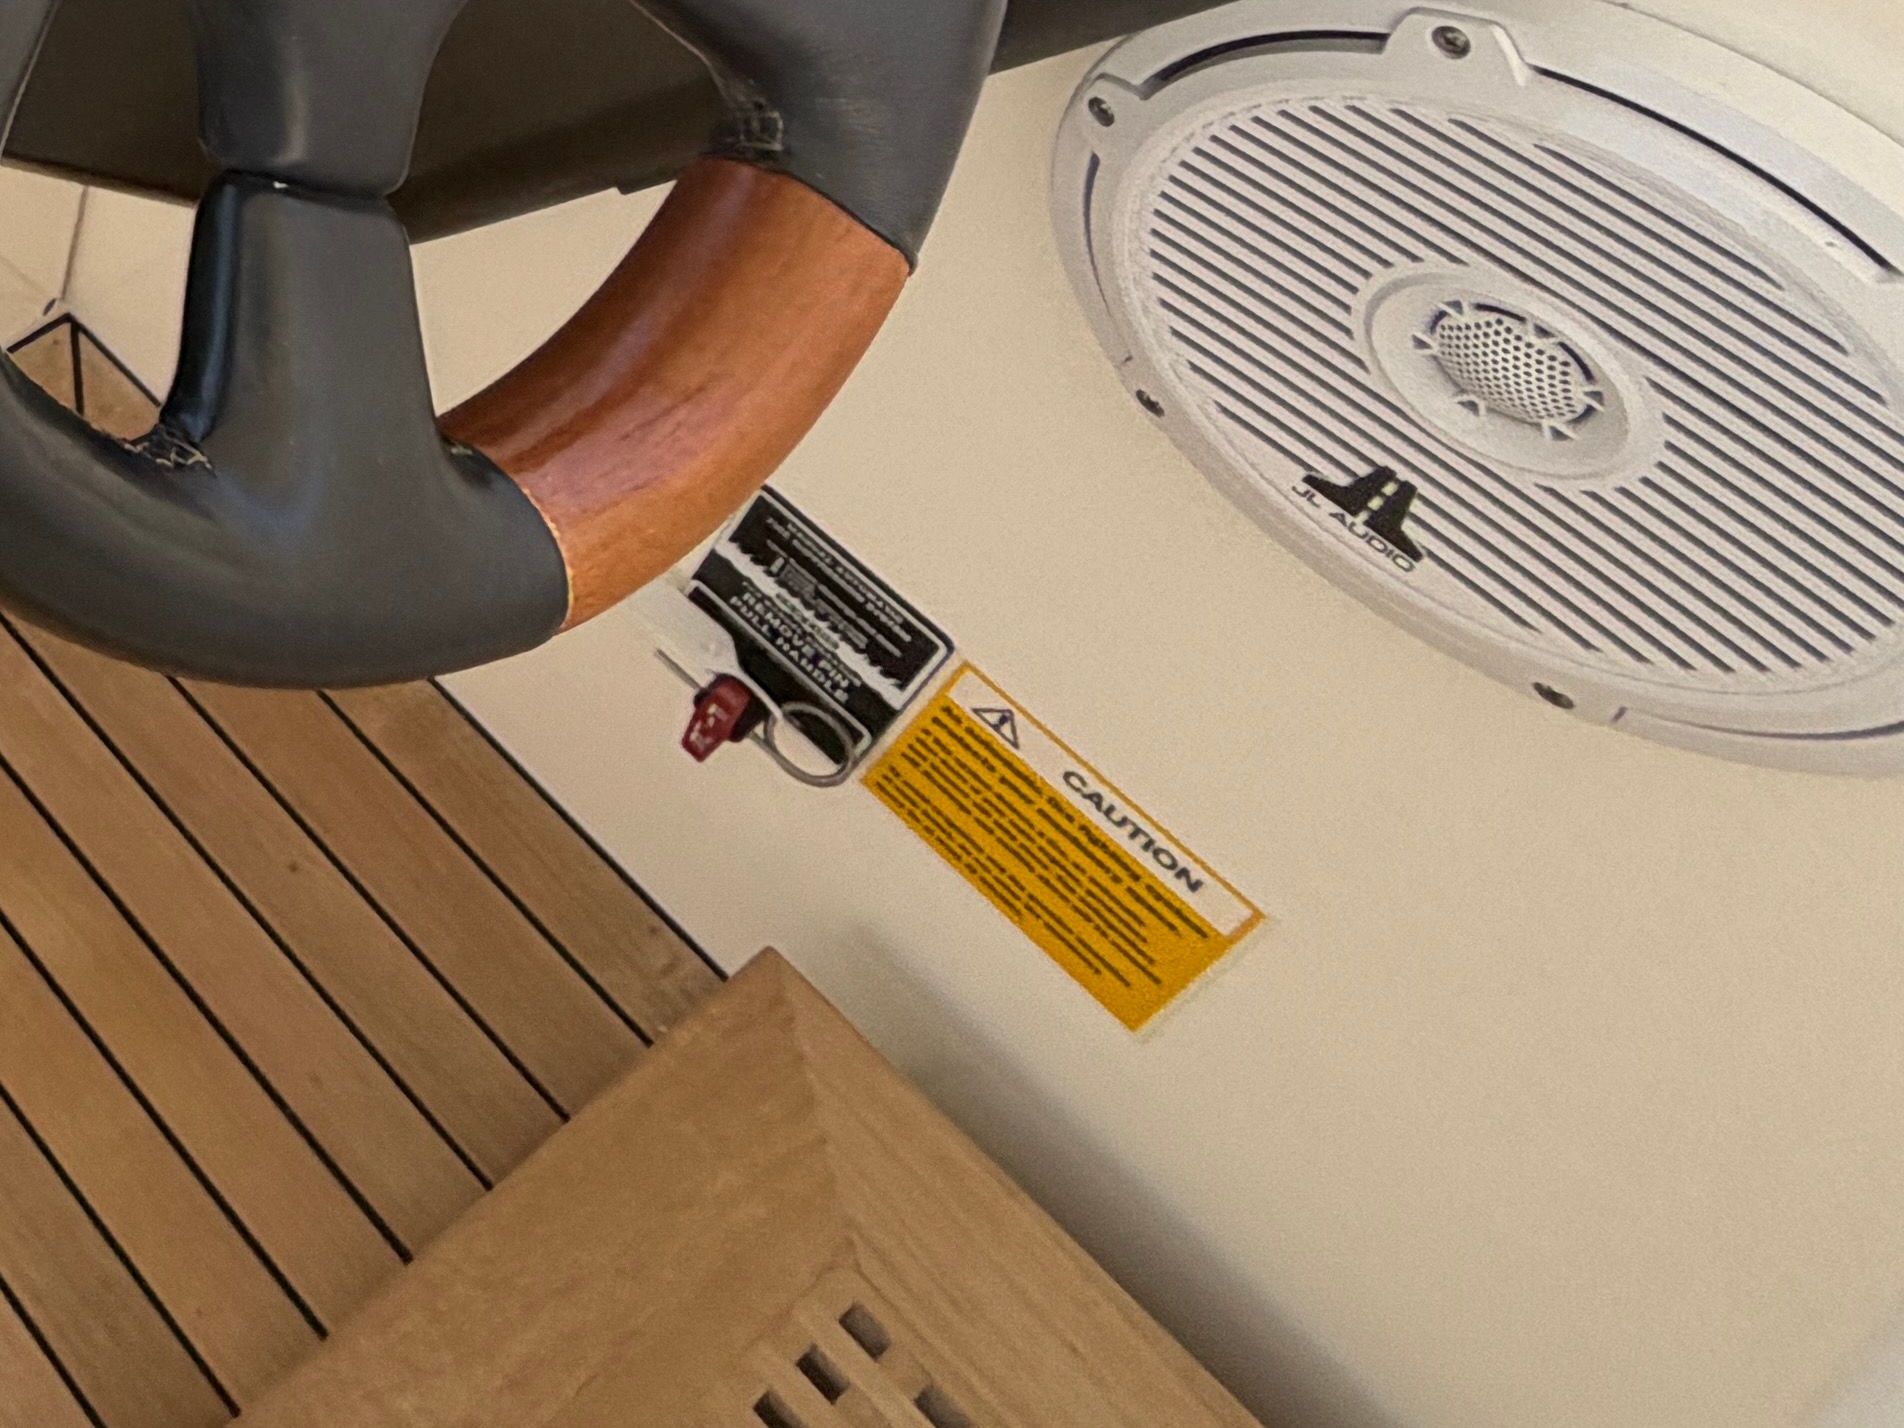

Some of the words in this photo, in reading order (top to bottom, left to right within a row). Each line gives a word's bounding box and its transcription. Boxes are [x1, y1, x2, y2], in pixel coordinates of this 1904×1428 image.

[1291, 485, 1321, 509] JL
[1327, 511, 1416, 573] AUDIO
[728, 594, 776, 638] PULL
[773, 635, 850, 704] HANDLE
[740, 591, 816, 659] REMOVE
[818, 659, 851, 689] PIN
[1062, 769, 1205, 893] CAUTION
